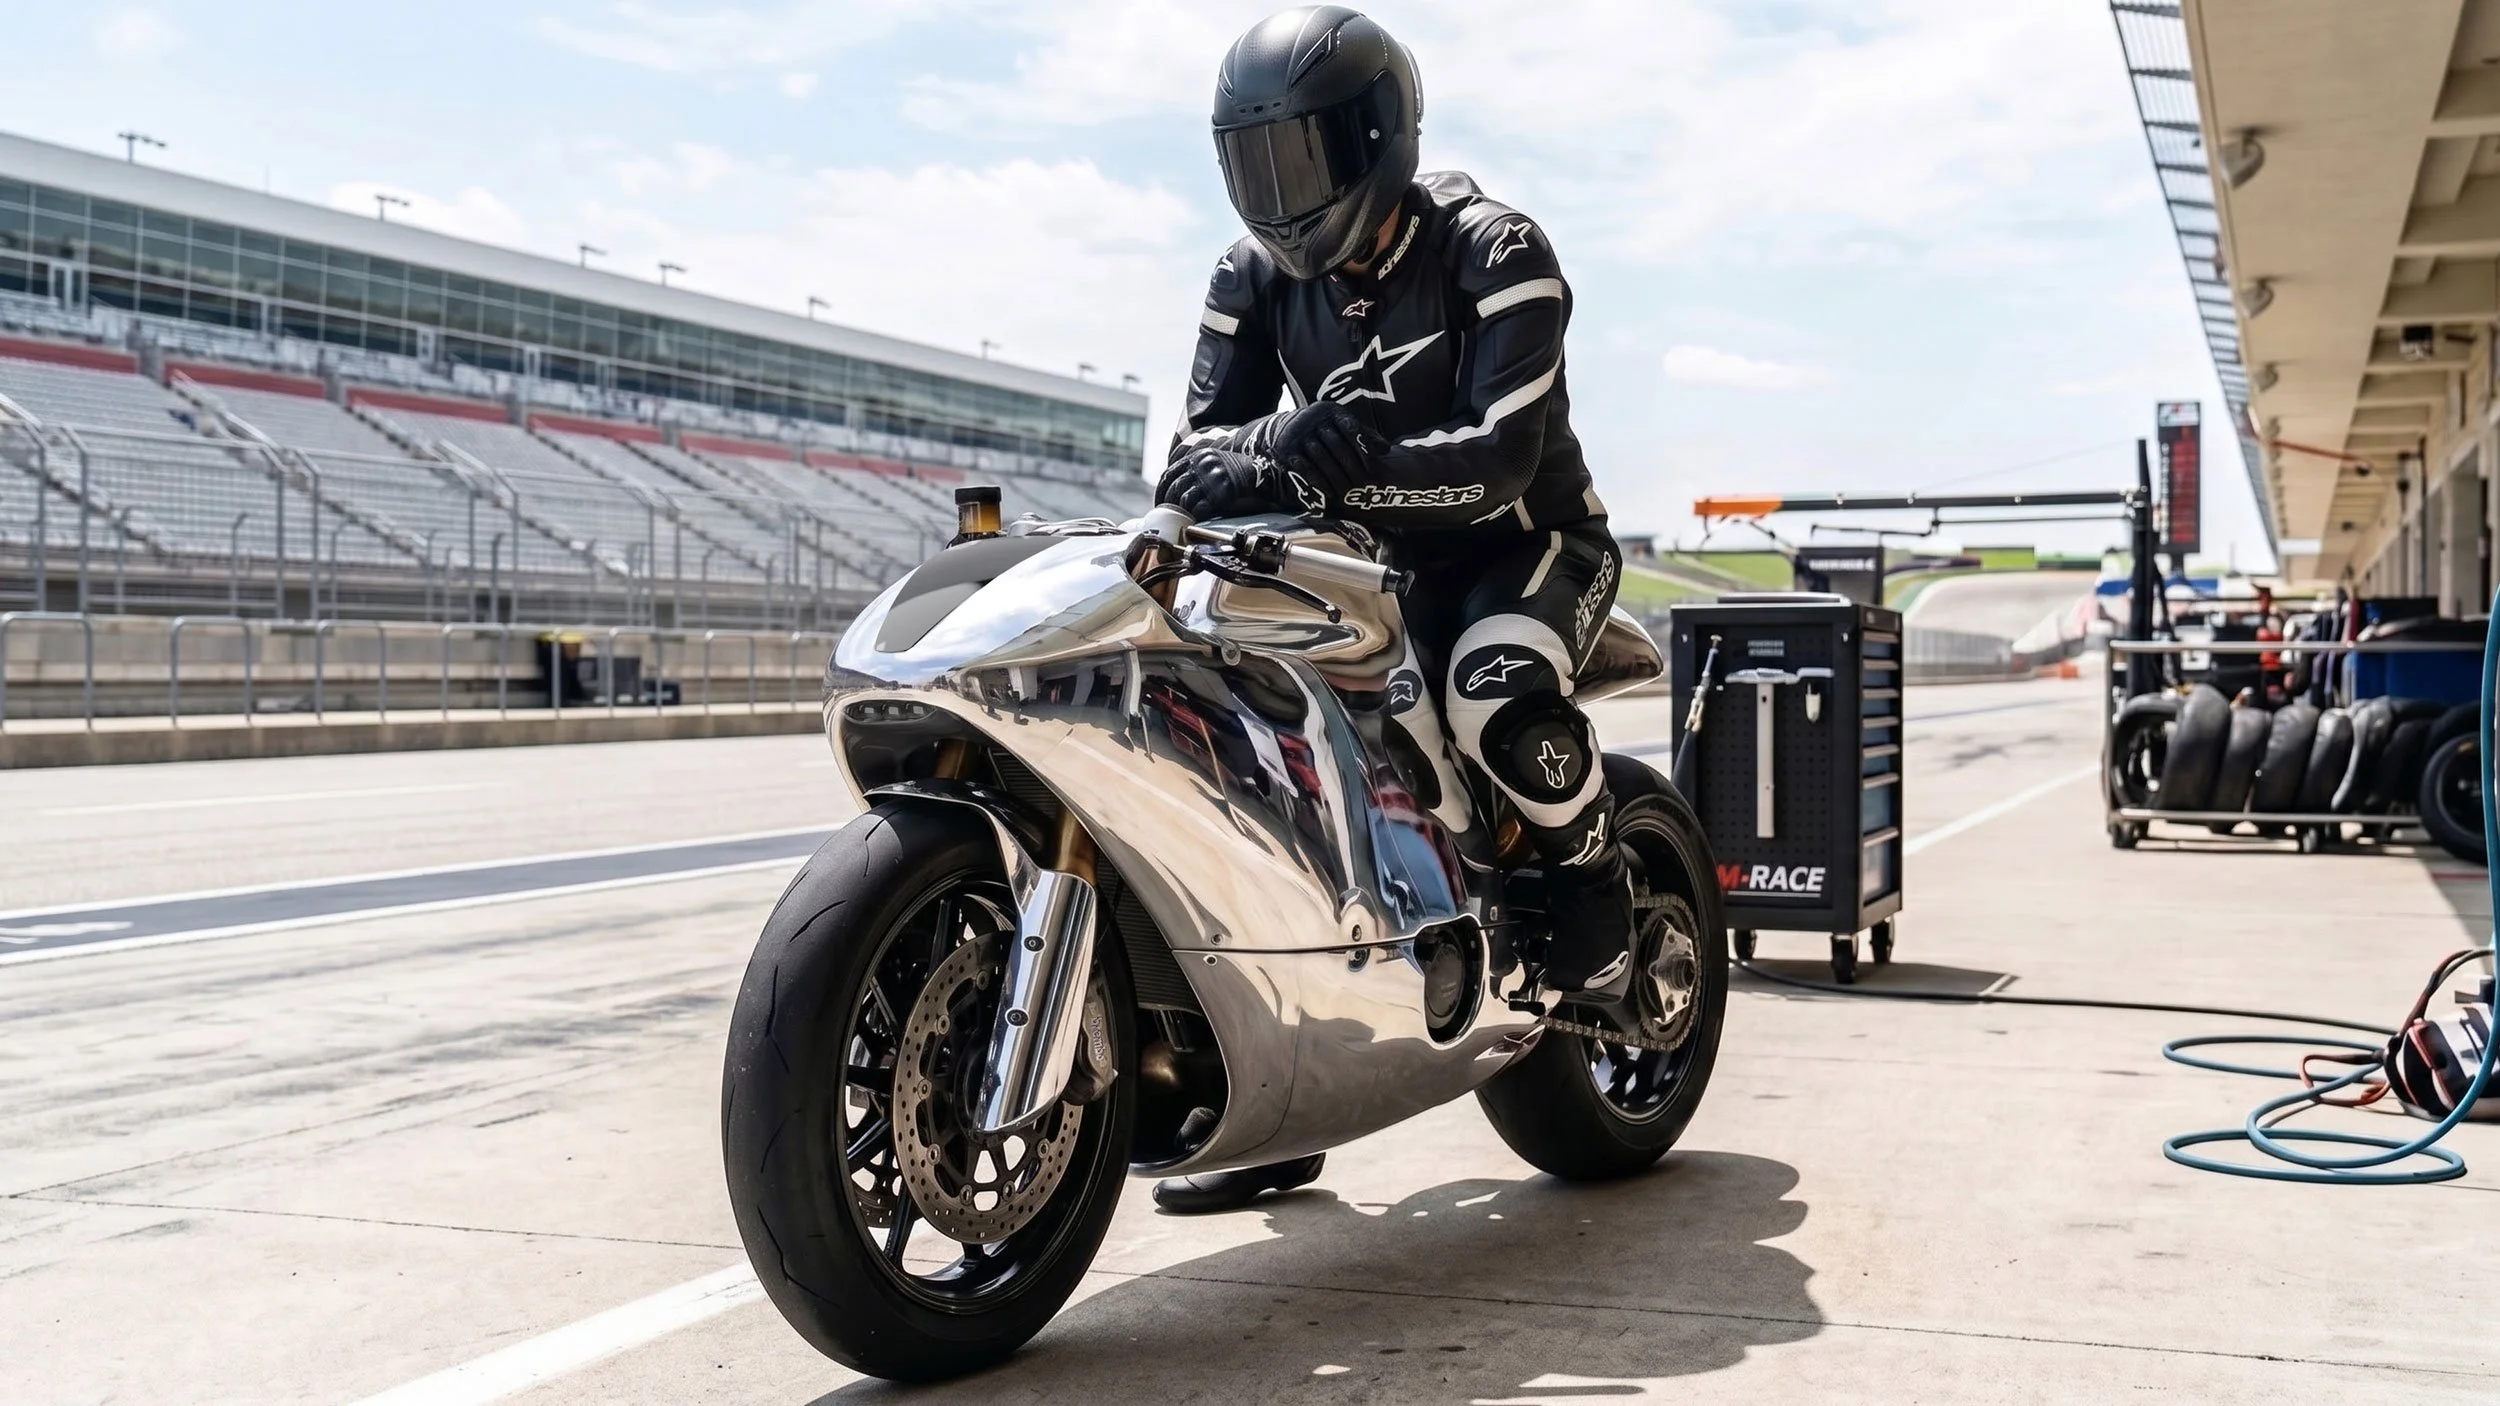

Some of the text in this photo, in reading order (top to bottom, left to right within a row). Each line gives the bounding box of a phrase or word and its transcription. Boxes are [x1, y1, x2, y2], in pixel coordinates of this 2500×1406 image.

[1344, 484, 1484, 510] alpinestars
[1716, 863, 1826, 891] M-RACE
[1091, 1015, 1105, 1061] brembo
